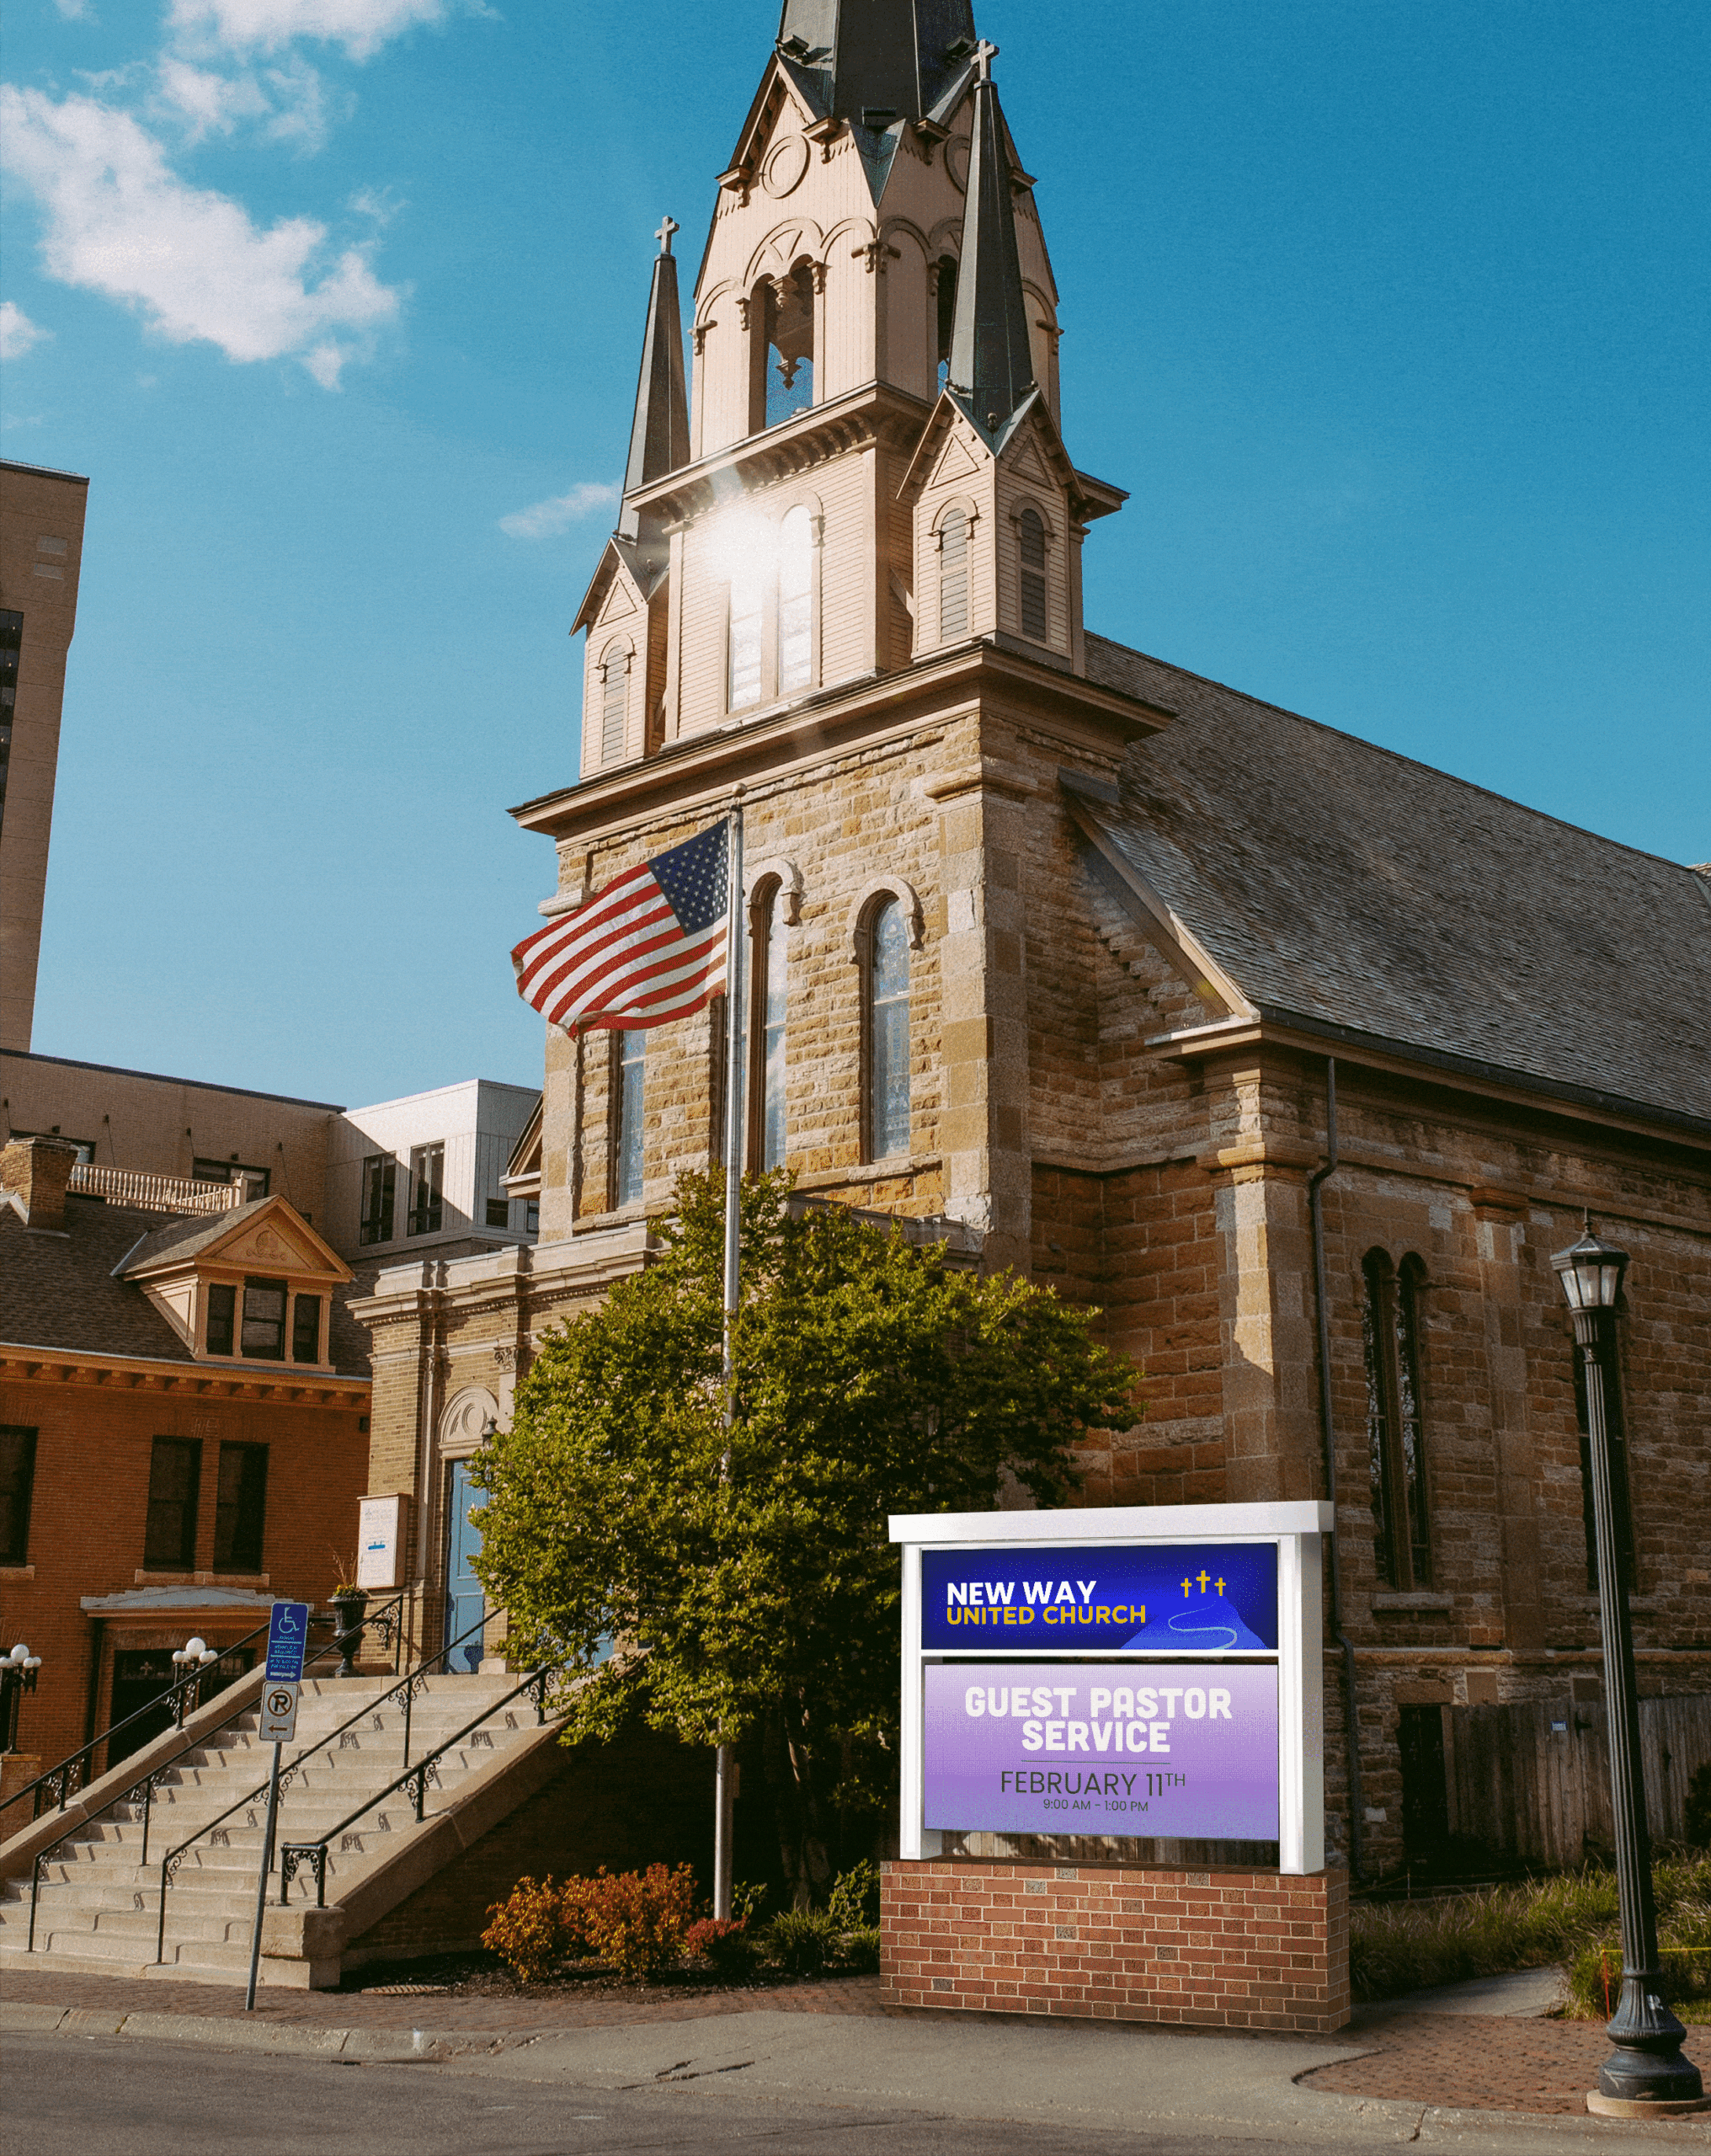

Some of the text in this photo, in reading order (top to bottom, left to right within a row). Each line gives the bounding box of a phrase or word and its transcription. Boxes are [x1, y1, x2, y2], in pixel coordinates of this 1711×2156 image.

[947, 1580, 1097, 1605] NEW WAY
[946, 1604, 1146, 1625] UNITED CHURCH
[965, 1686, 1233, 1720] GUEST PASTOR
[1021, 1720, 1170, 1753] SERVICE
[1001, 1770, 1186, 1796] FEBRUARY 11TH
[1042, 1798, 1069, 1810] 9:00
[1072, 1800, 1091, 1810] AM
[1104, 1800, 1127, 1812] 1:00
[1130, 1801, 1149, 1812] PM
